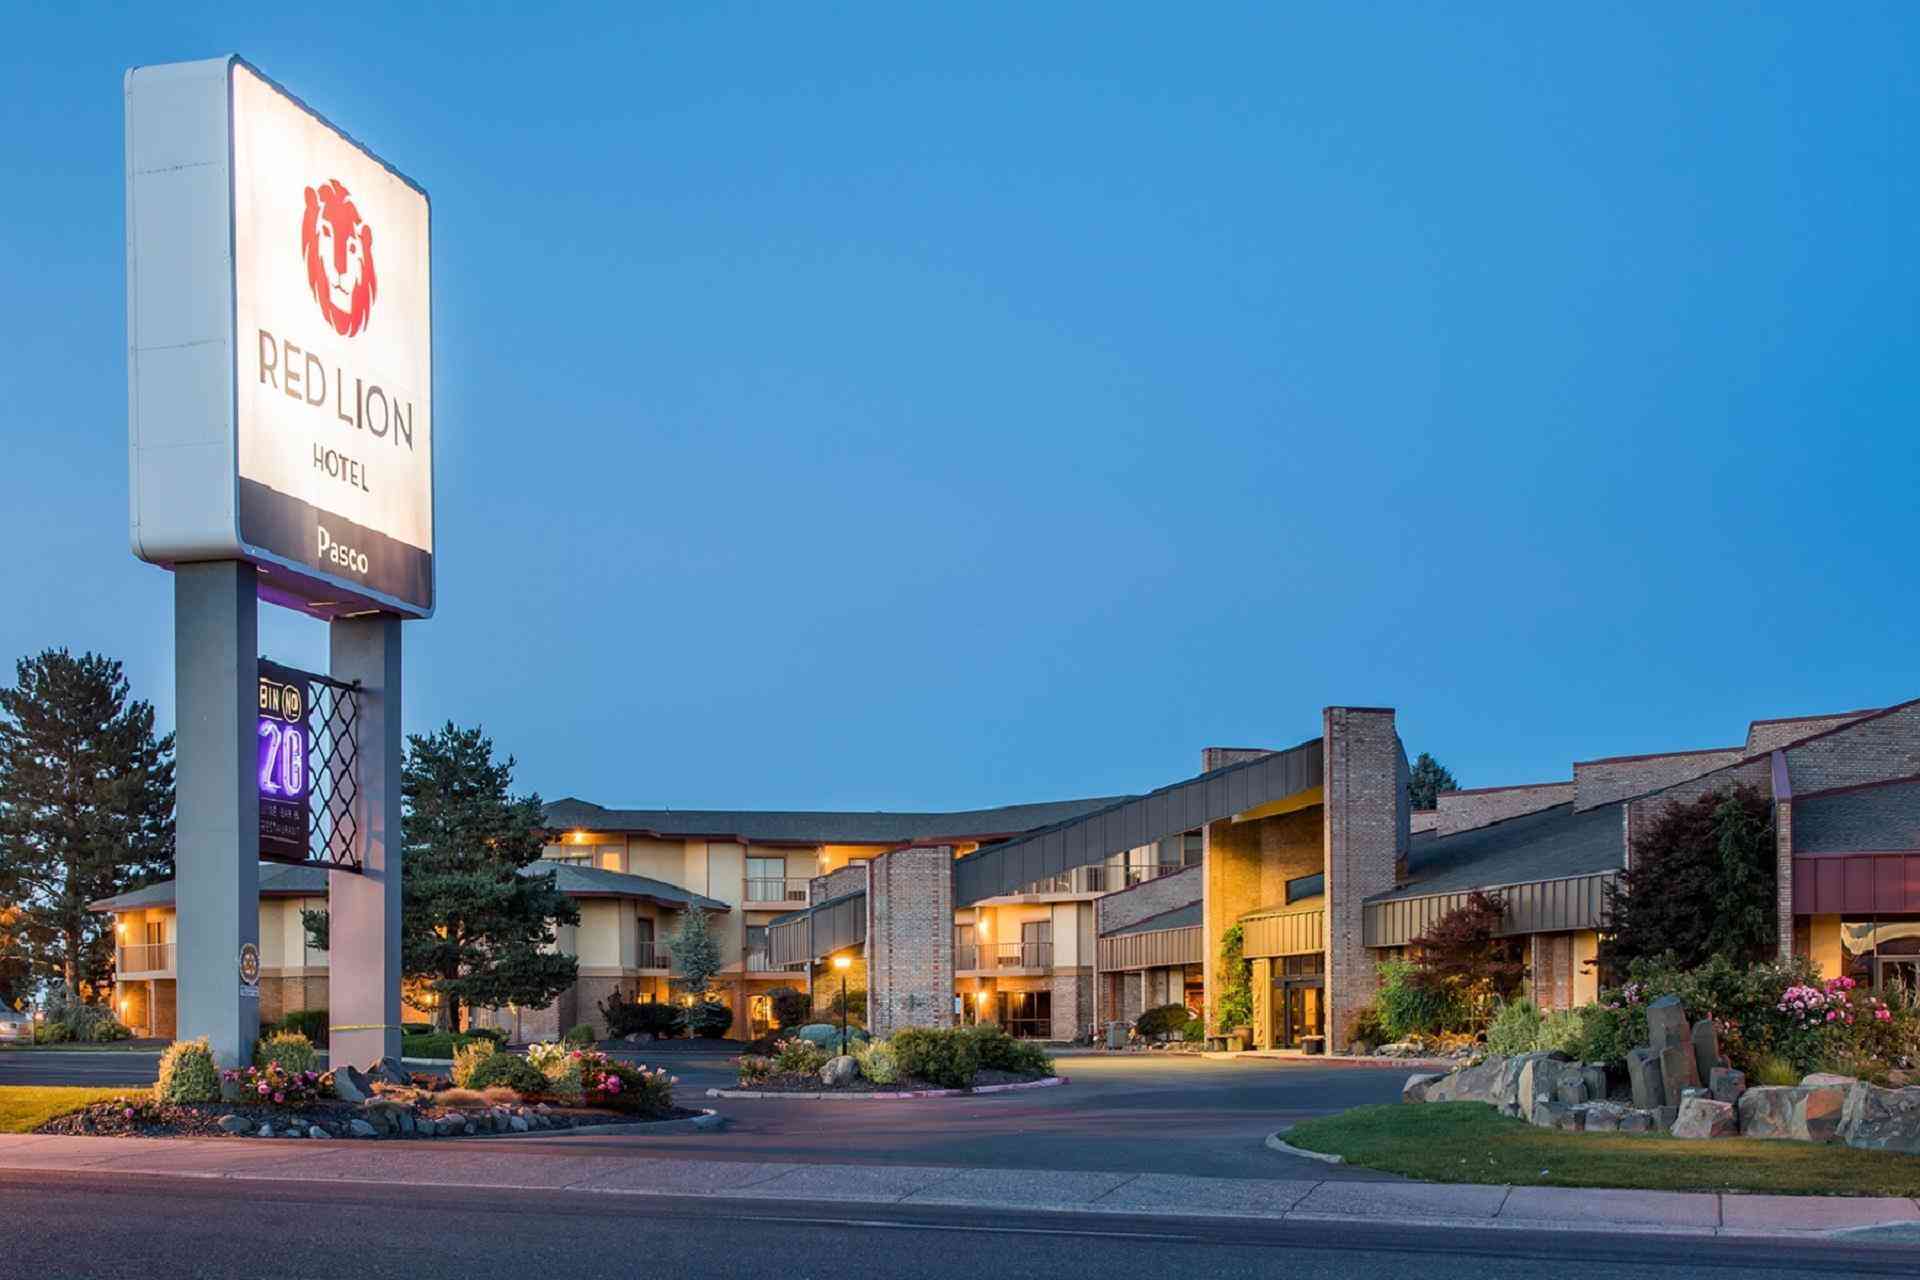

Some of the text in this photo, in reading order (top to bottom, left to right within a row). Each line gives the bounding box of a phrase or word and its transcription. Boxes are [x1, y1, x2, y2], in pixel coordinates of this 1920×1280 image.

[258, 329, 414, 451] RED LION
[313, 443, 370, 493] HOTEL
[317, 525, 369, 574] Pasco
[259, 721, 302, 796] 20
